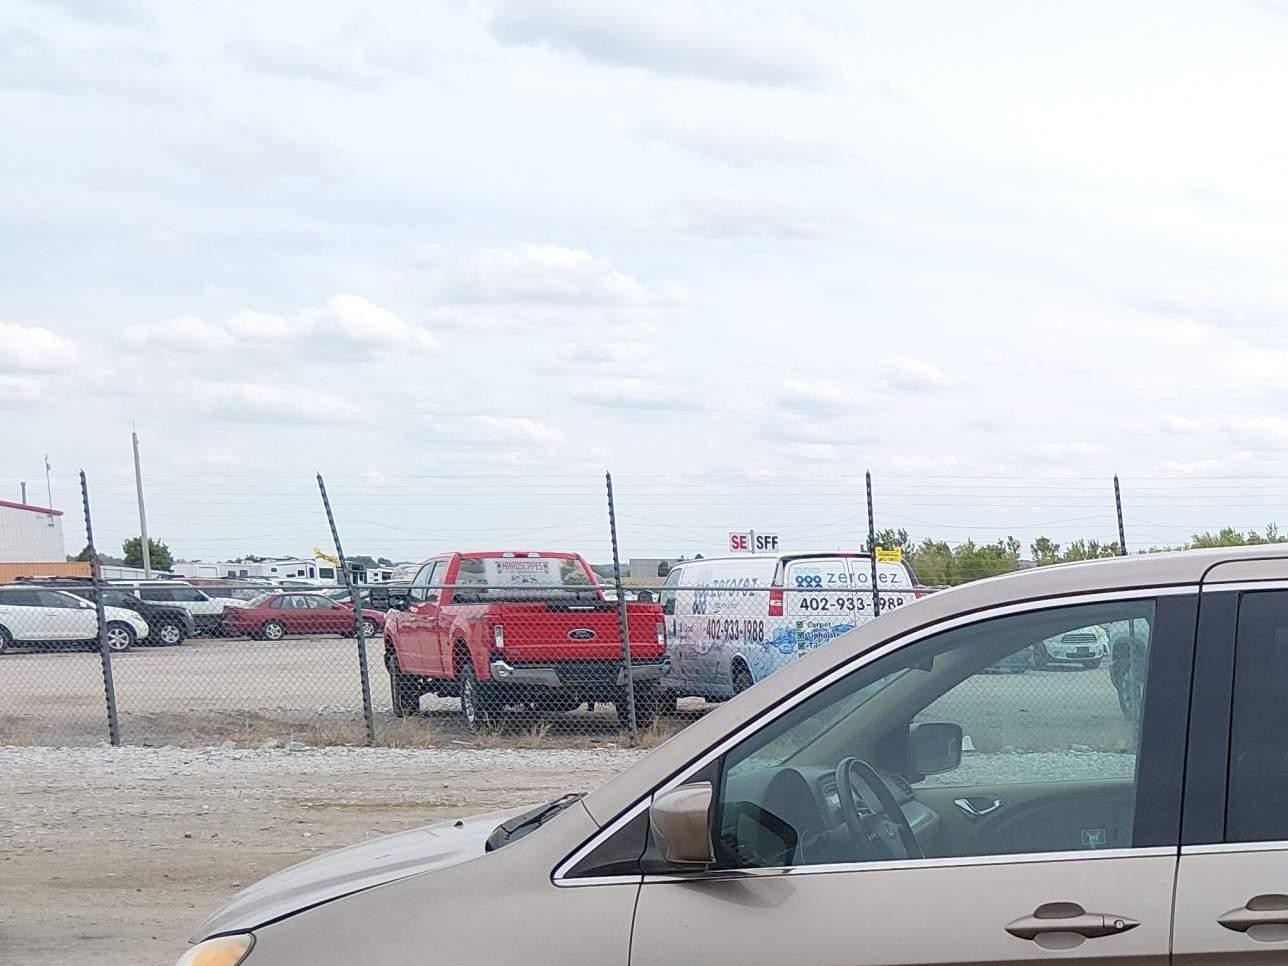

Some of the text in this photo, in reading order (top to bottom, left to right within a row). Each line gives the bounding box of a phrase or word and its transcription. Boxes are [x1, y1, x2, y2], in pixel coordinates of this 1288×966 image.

[731, 535, 748, 550] SE
[756, 535, 779, 550] SFF
[826, 572, 900, 584] zeroez
[706, 618, 764, 642] 402-933-1988
[807, 621, 831, 630] Carpet
